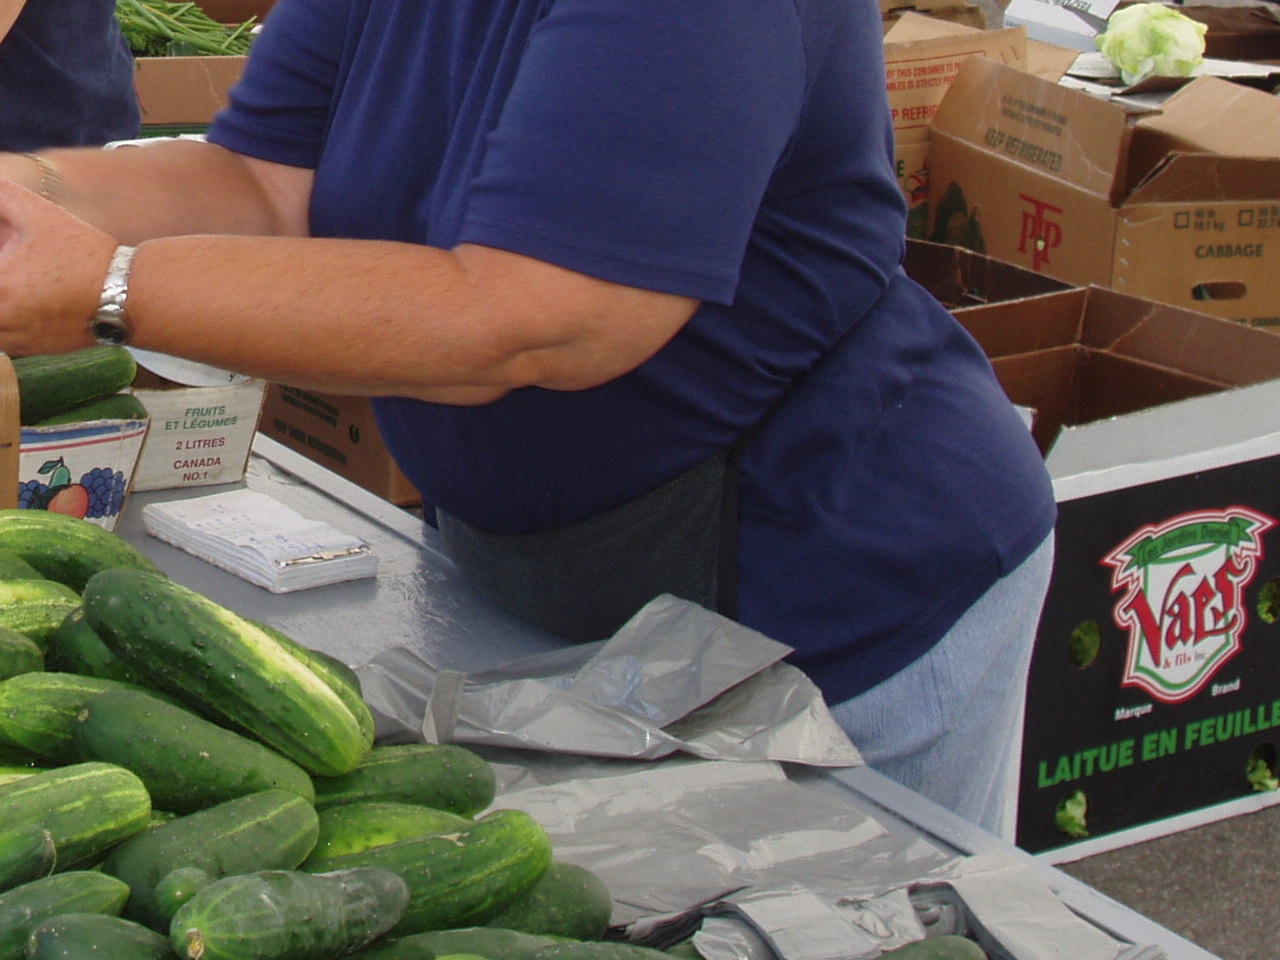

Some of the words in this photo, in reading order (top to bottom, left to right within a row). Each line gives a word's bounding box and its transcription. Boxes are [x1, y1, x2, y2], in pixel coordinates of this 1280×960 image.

[897, 68, 912, 78] THIS
[916, 77, 943, 89] STRICTLY
[1004, 133, 1064, 173] REFRIGERATED
[1195, 243, 1265, 259] CABBAGE
[185, 405, 226, 417] FRUITS
[165, 420, 180, 431] ET
[183, 416, 238, 430] LÉGUMES
[175, 441, 183, 451] 2
[185, 437, 226, 450] LITRES
[173, 456, 222, 470] CANADA
[1175, 652, 1192, 667] fils
[1211, 678, 1241, 696] Brand
[1114, 703, 1153, 721] Marque
[1038, 738, 1136, 789] LAITUE
[1141, 727, 1178, 762] EN
